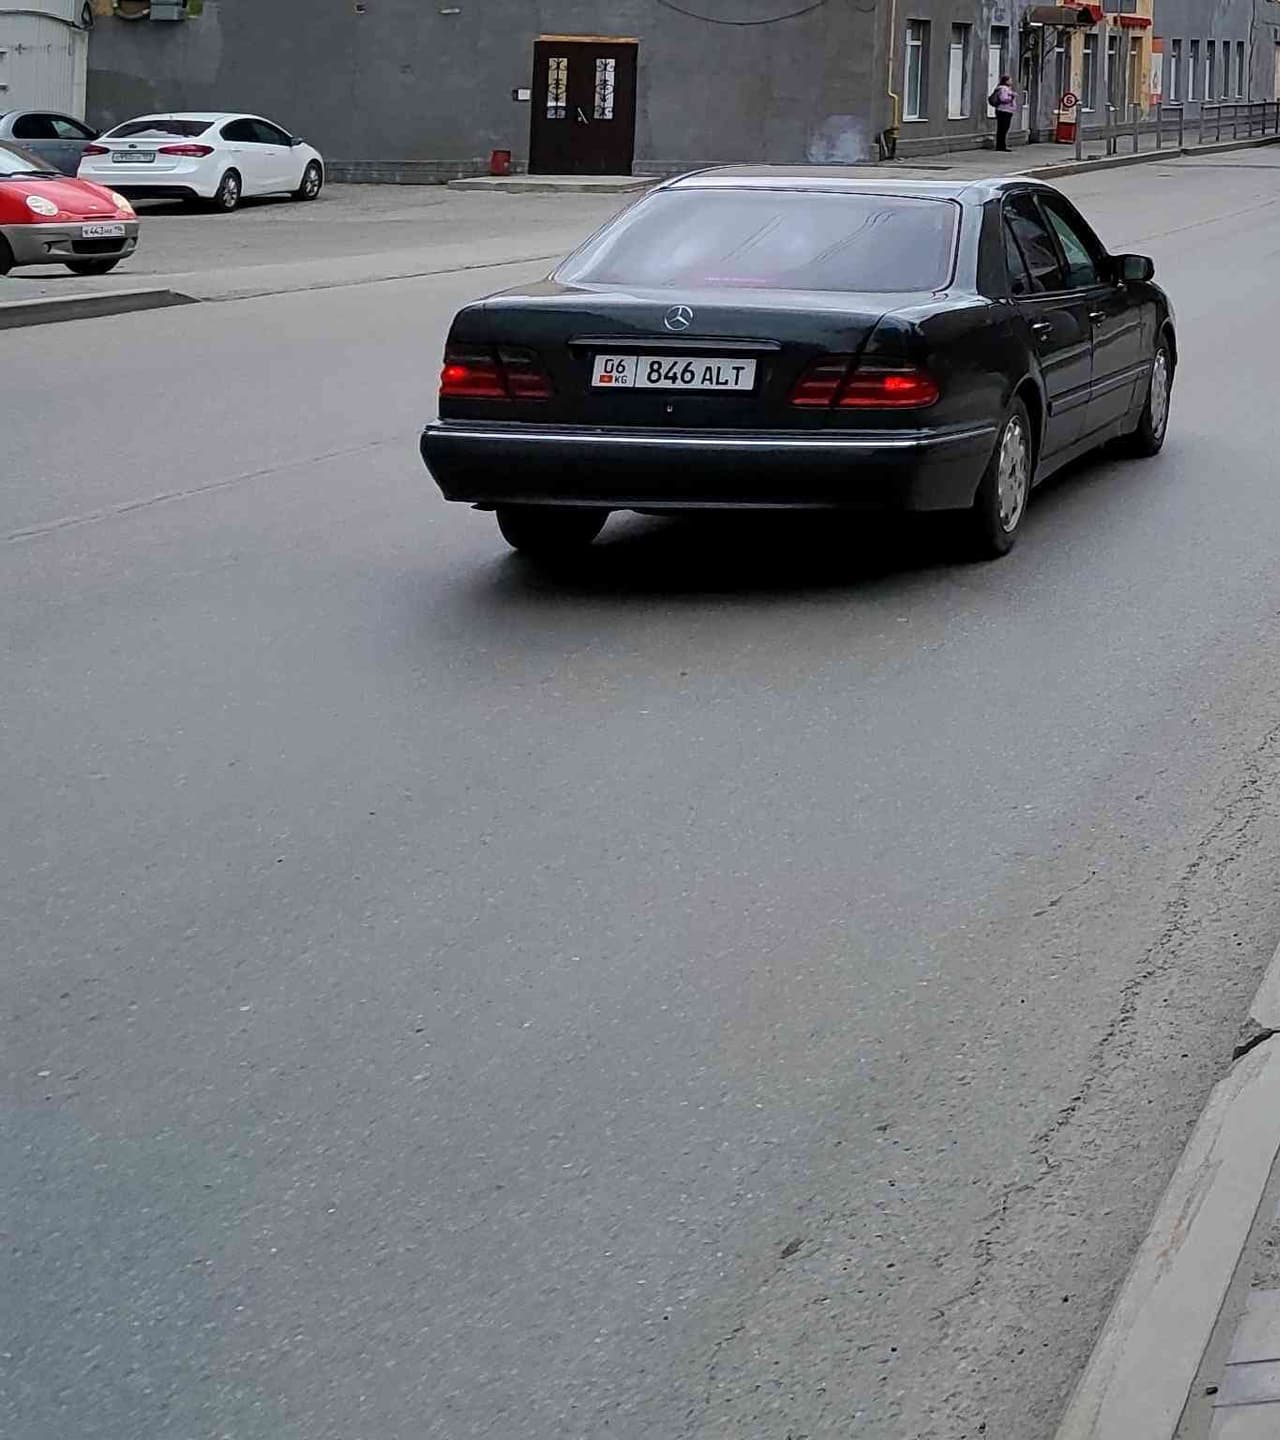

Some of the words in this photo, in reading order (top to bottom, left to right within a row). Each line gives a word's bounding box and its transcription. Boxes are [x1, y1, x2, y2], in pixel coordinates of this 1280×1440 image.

[604, 359, 626, 374] 06
[646, 360, 696, 385] 846
[701, 366, 746, 386] ALT
[614, 375, 628, 385] KG
